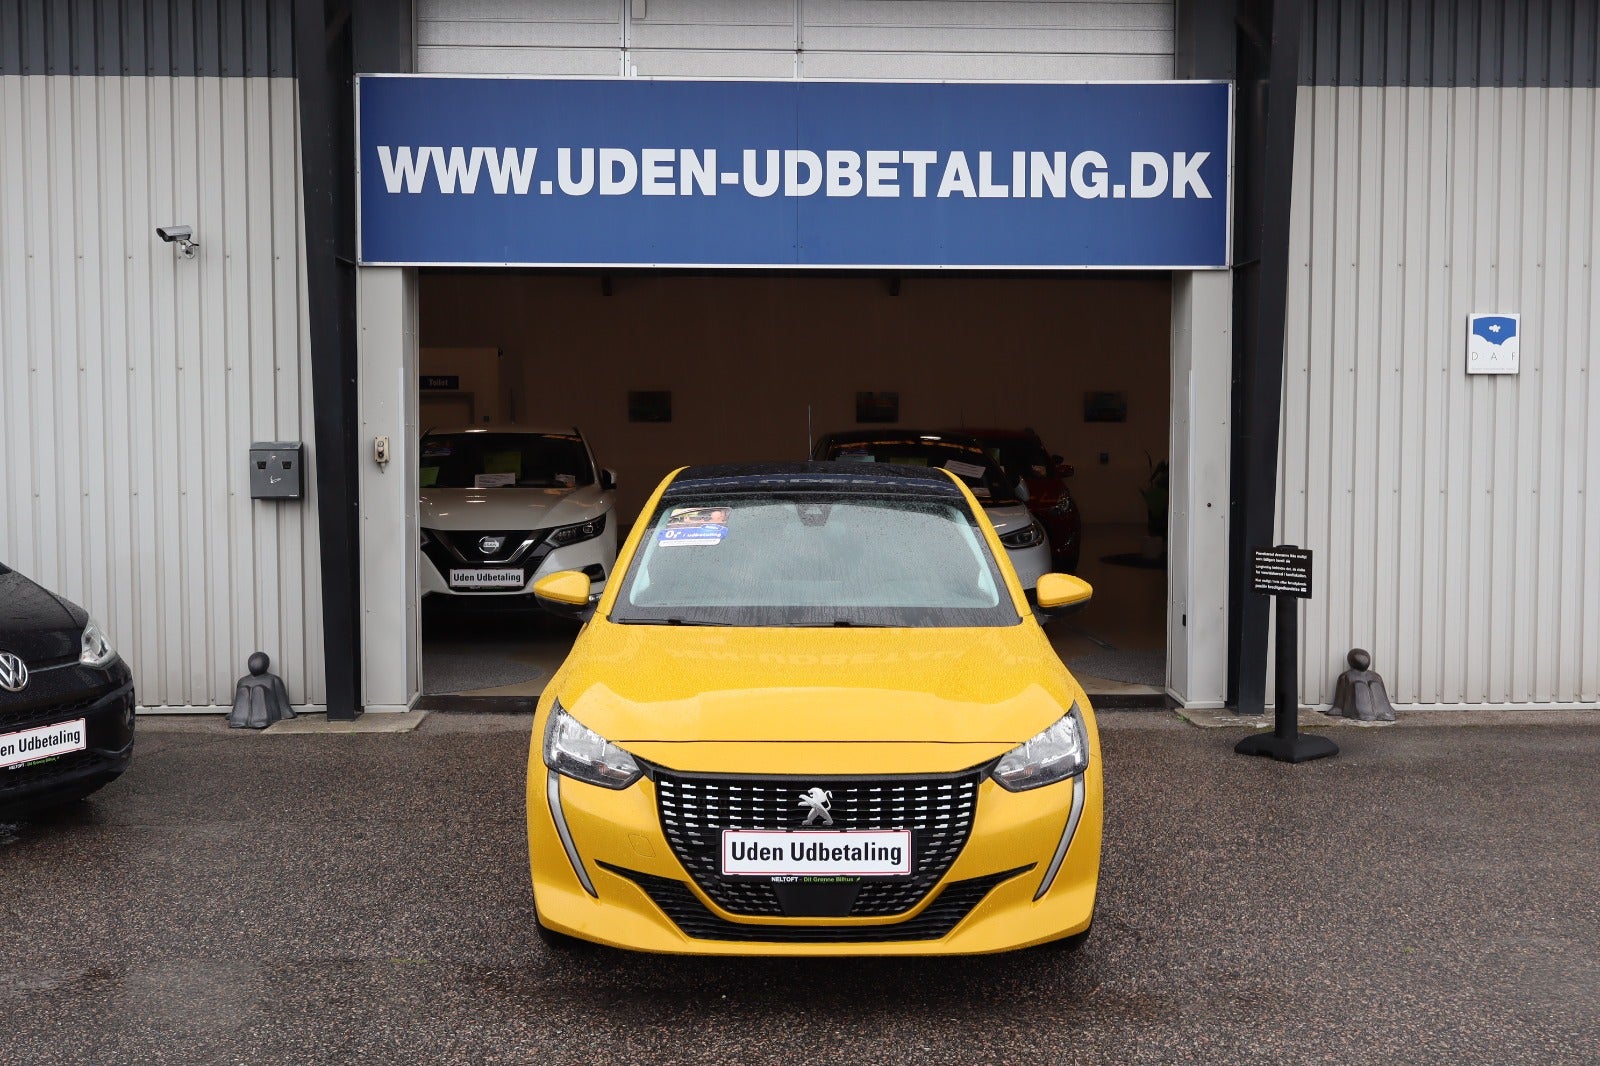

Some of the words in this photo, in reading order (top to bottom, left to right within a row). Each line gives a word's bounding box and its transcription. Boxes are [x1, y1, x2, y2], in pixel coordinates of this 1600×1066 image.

[376, 145, 1213, 200] WWW.UDEN-UDBETALING.DK
[453, 573, 475, 582] Uden
[476, 572, 521, 583] Udbetaling
[18, 730, 81, 753] Udbetaling
[731, 841, 784, 861] Uden
[790, 841, 902, 866] Udbetaling
